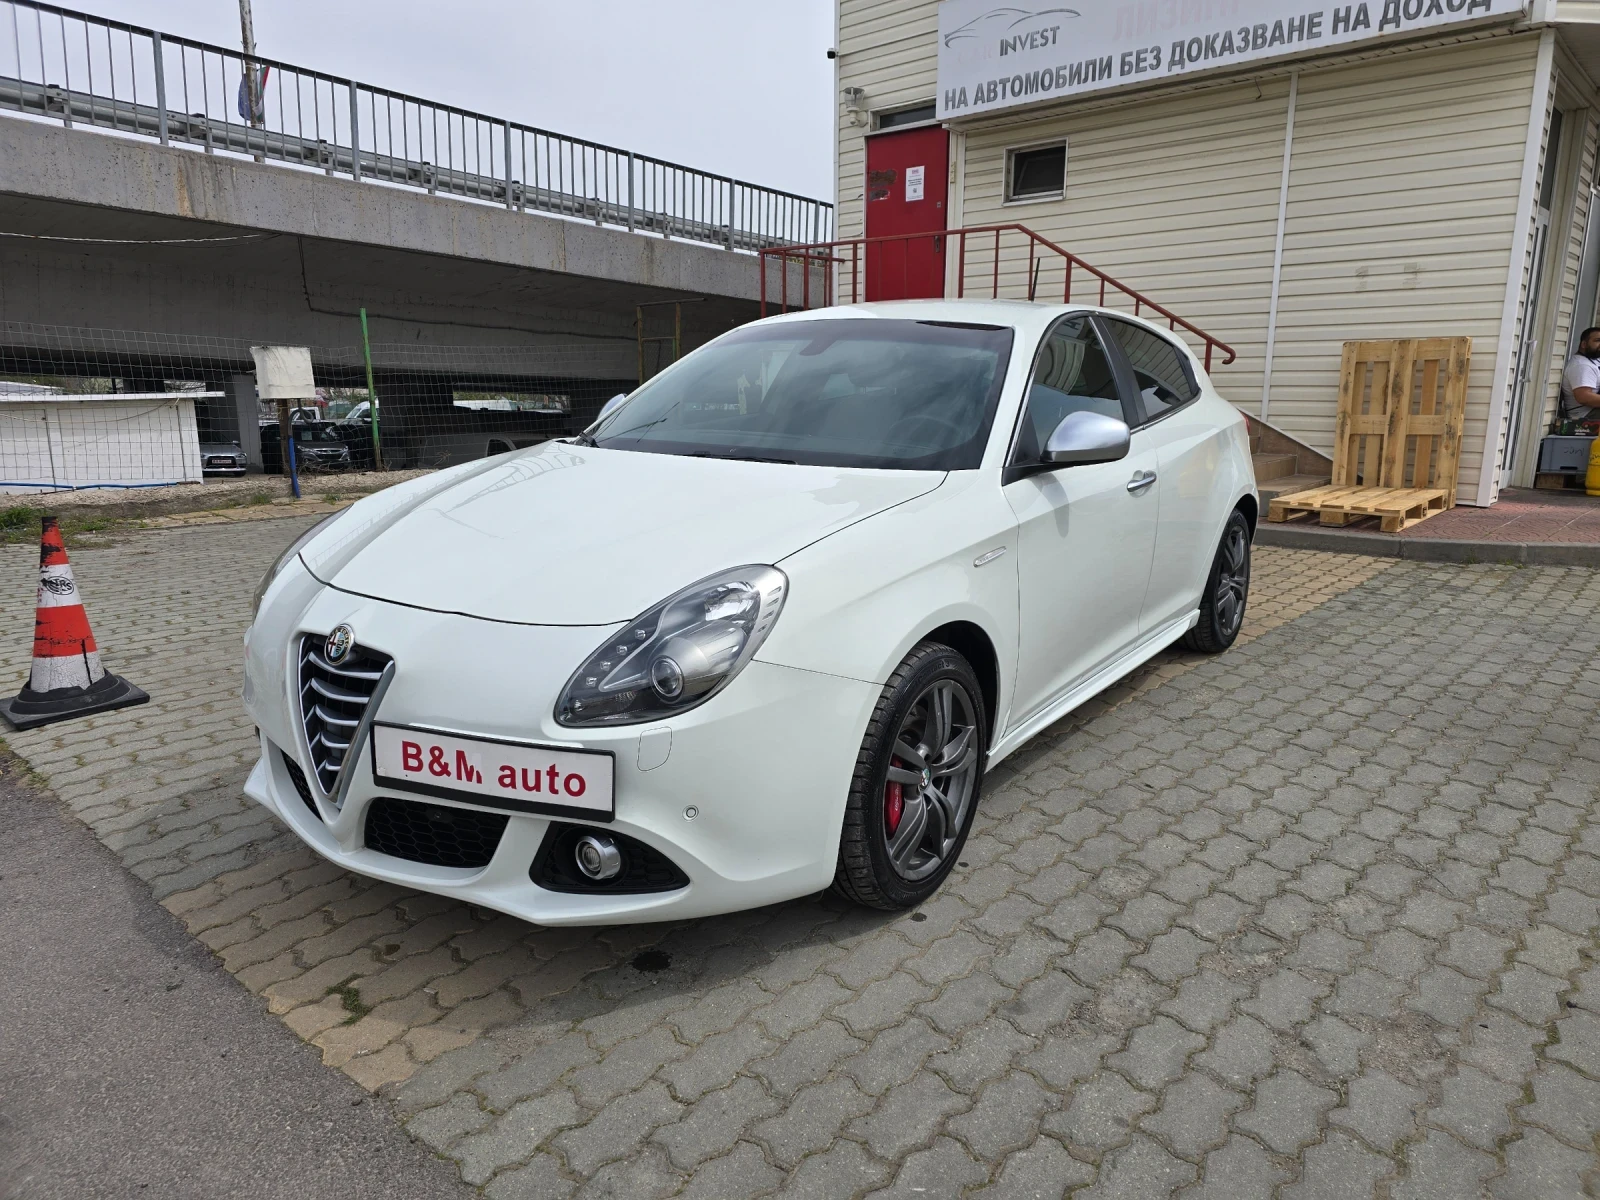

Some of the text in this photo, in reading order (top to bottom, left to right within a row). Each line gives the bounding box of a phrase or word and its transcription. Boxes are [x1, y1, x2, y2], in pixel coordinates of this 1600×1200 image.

[944, 86, 969, 111] НА
[973, 55, 1113, 106] АВТОМОБИЛИ
[1119, 45, 1162, 77] БЕЗ
[1167, 11, 1324, 72] ДОКАЗВАНЕ
[1332, 2, 1371, 35] НА
[999, 25, 1060, 57] INVEST
[402, 740, 587, 797] B&M auto
